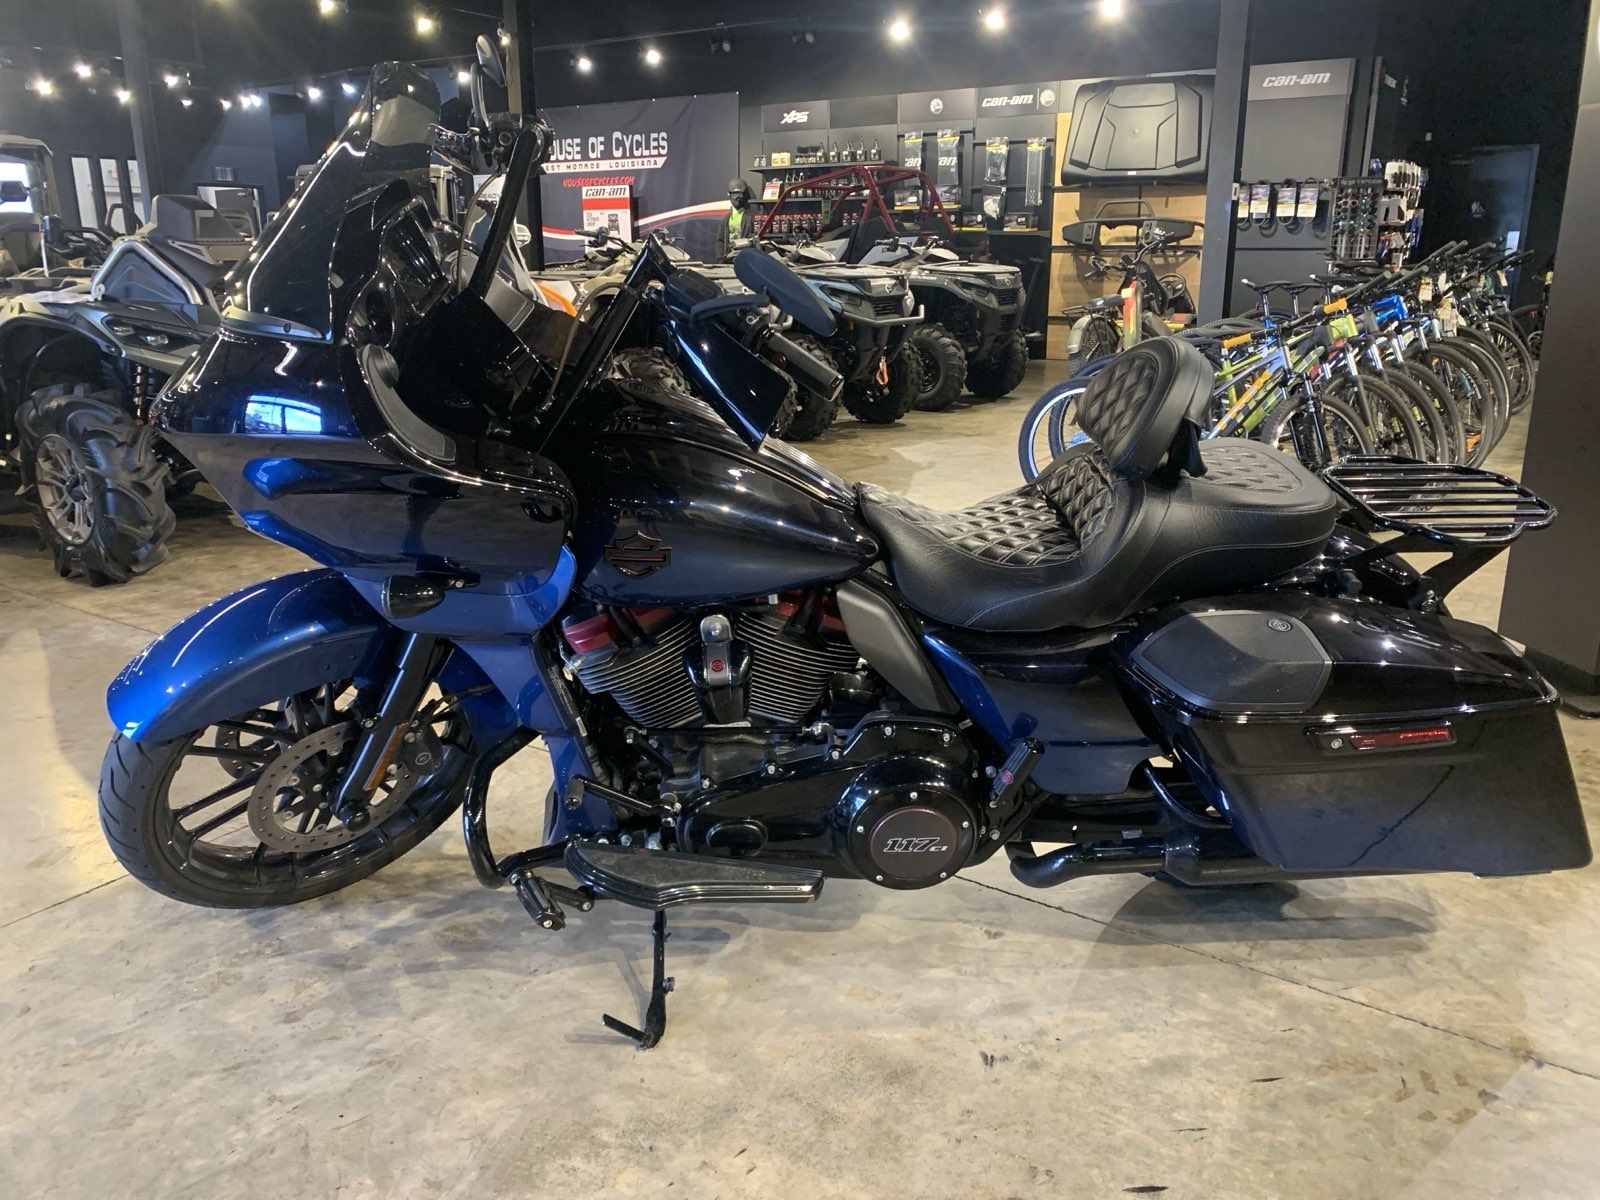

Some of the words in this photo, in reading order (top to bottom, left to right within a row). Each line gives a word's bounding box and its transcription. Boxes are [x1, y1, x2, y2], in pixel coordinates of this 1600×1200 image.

[1262, 72, 1331, 88] can-am
[982, 94, 1034, 108] can-am
[549, 138, 582, 161] OUSE
[588, 136, 605, 159] OF
[545, 164, 561, 172] EST
[566, 162, 601, 171] MONROE
[609, 160, 658, 169] LOUISIANA
[585, 187, 627, 197] can-am
[883, 837, 940, 853] 117
